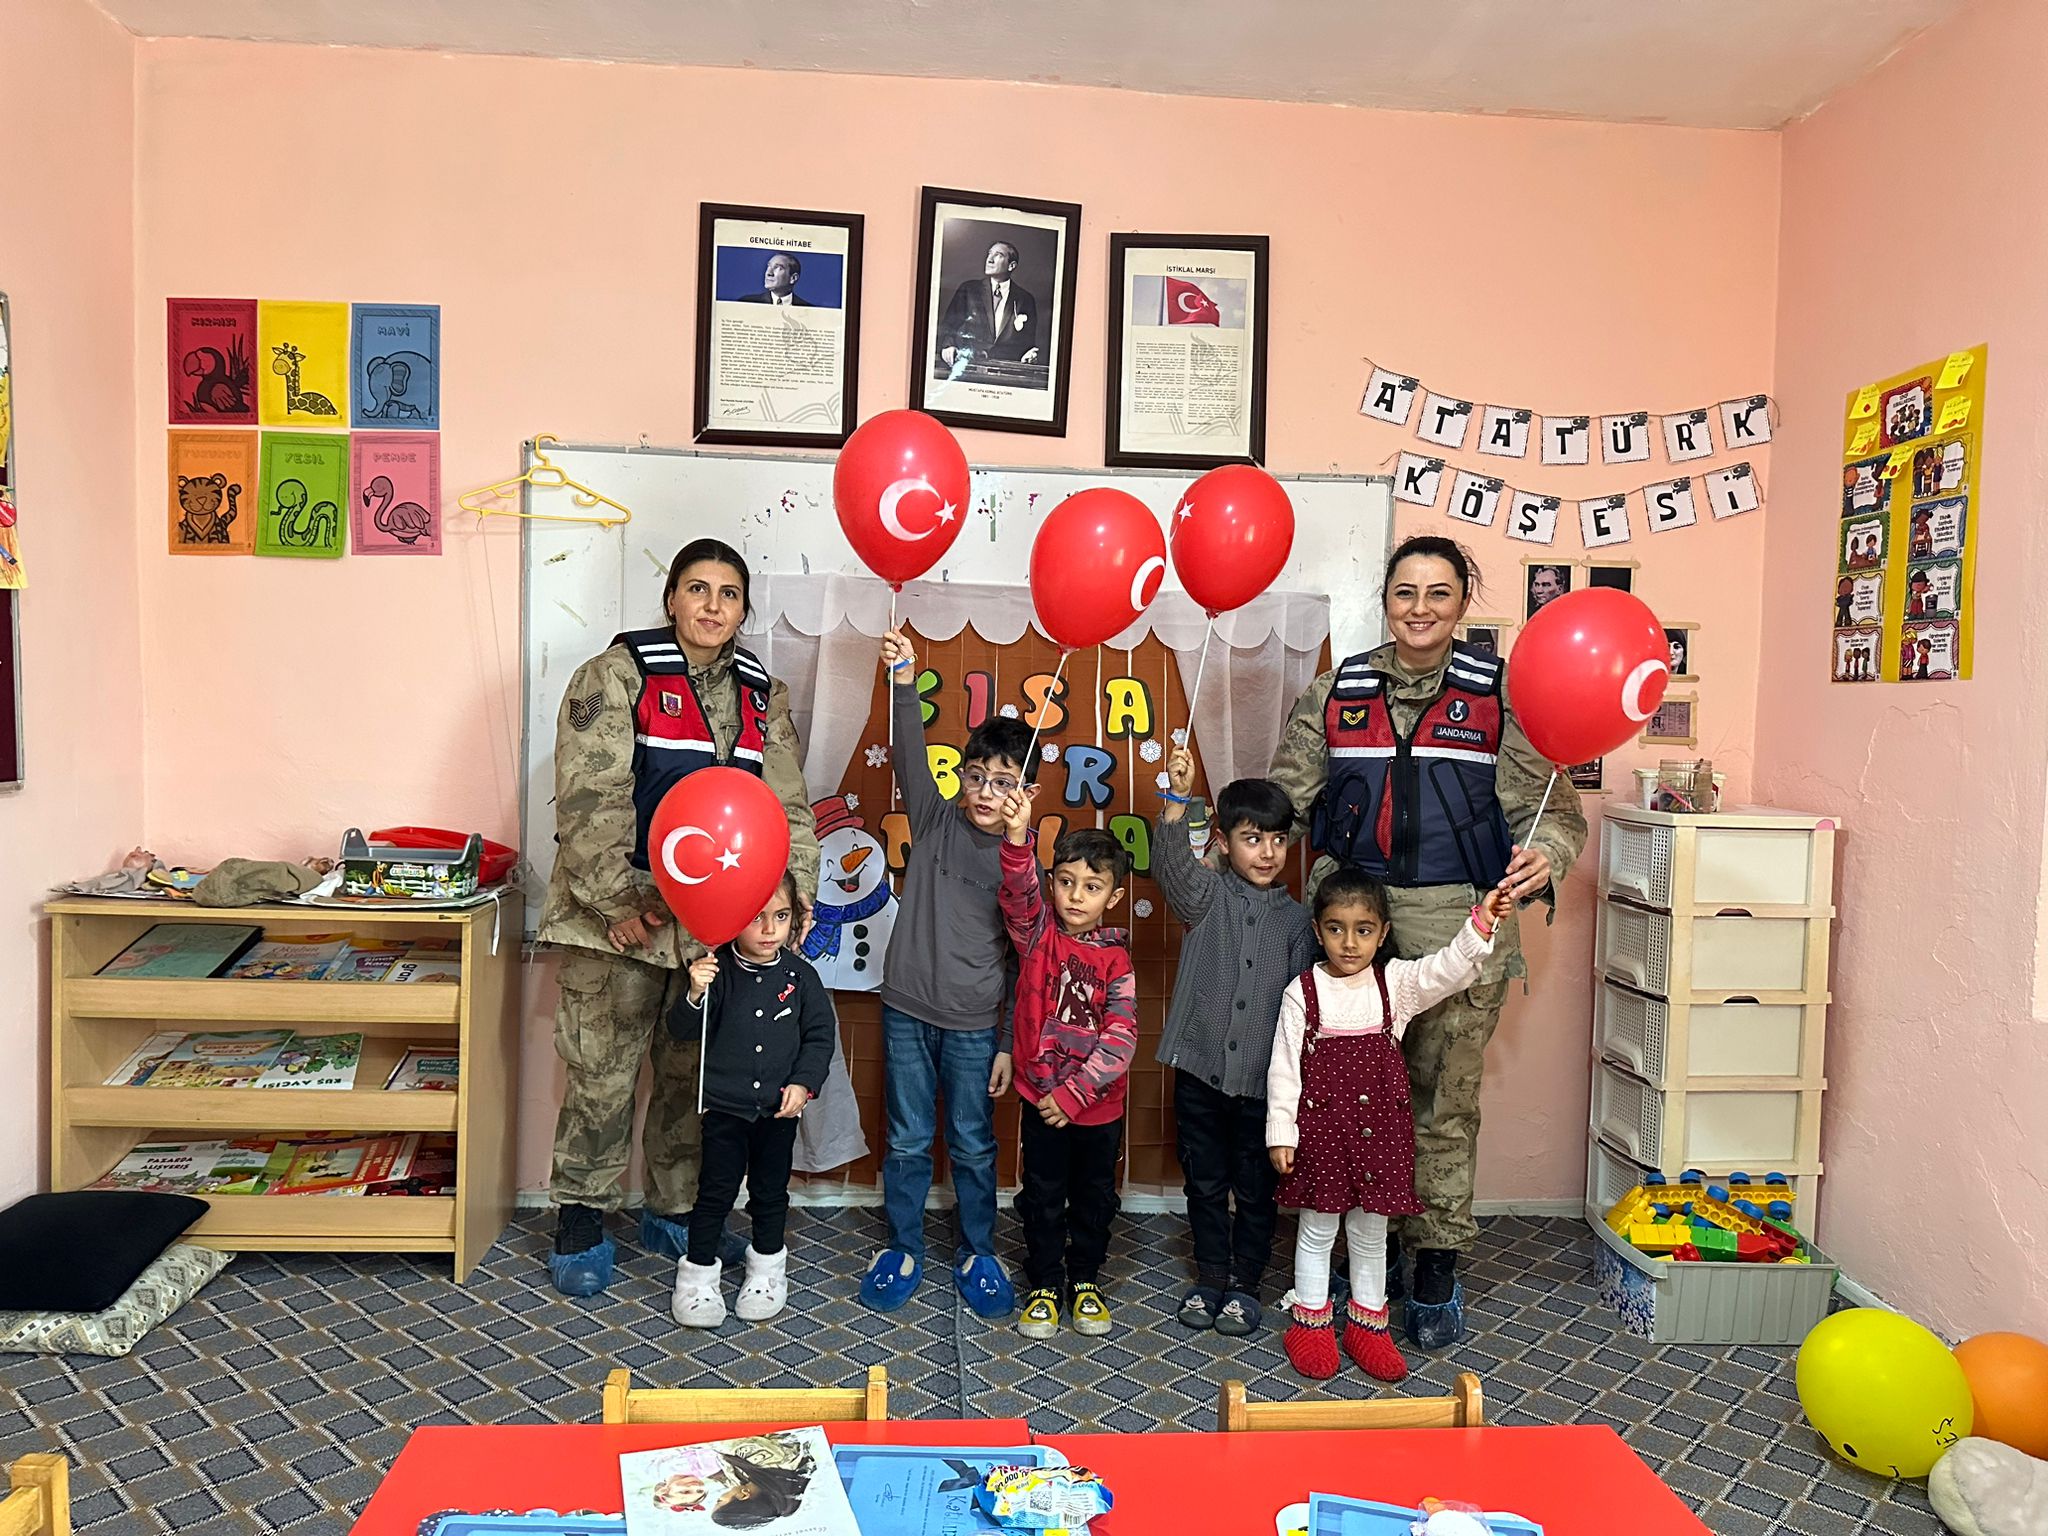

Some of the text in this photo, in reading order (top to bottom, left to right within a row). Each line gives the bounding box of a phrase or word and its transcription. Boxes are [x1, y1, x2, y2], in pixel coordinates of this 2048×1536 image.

[749, 236, 812, 248] GENÇLİĞE HİTABE
[1166, 265, 1195, 273] İSTİKLAL
[377, 323, 410, 337] MAVİ
[1373, 381, 1756, 455] ATATÜRK
[1404, 465, 1739, 538] KÖŞESİ
[1437, 727, 1482, 742] JANDARMA
[926, 743, 1117, 809] BR
